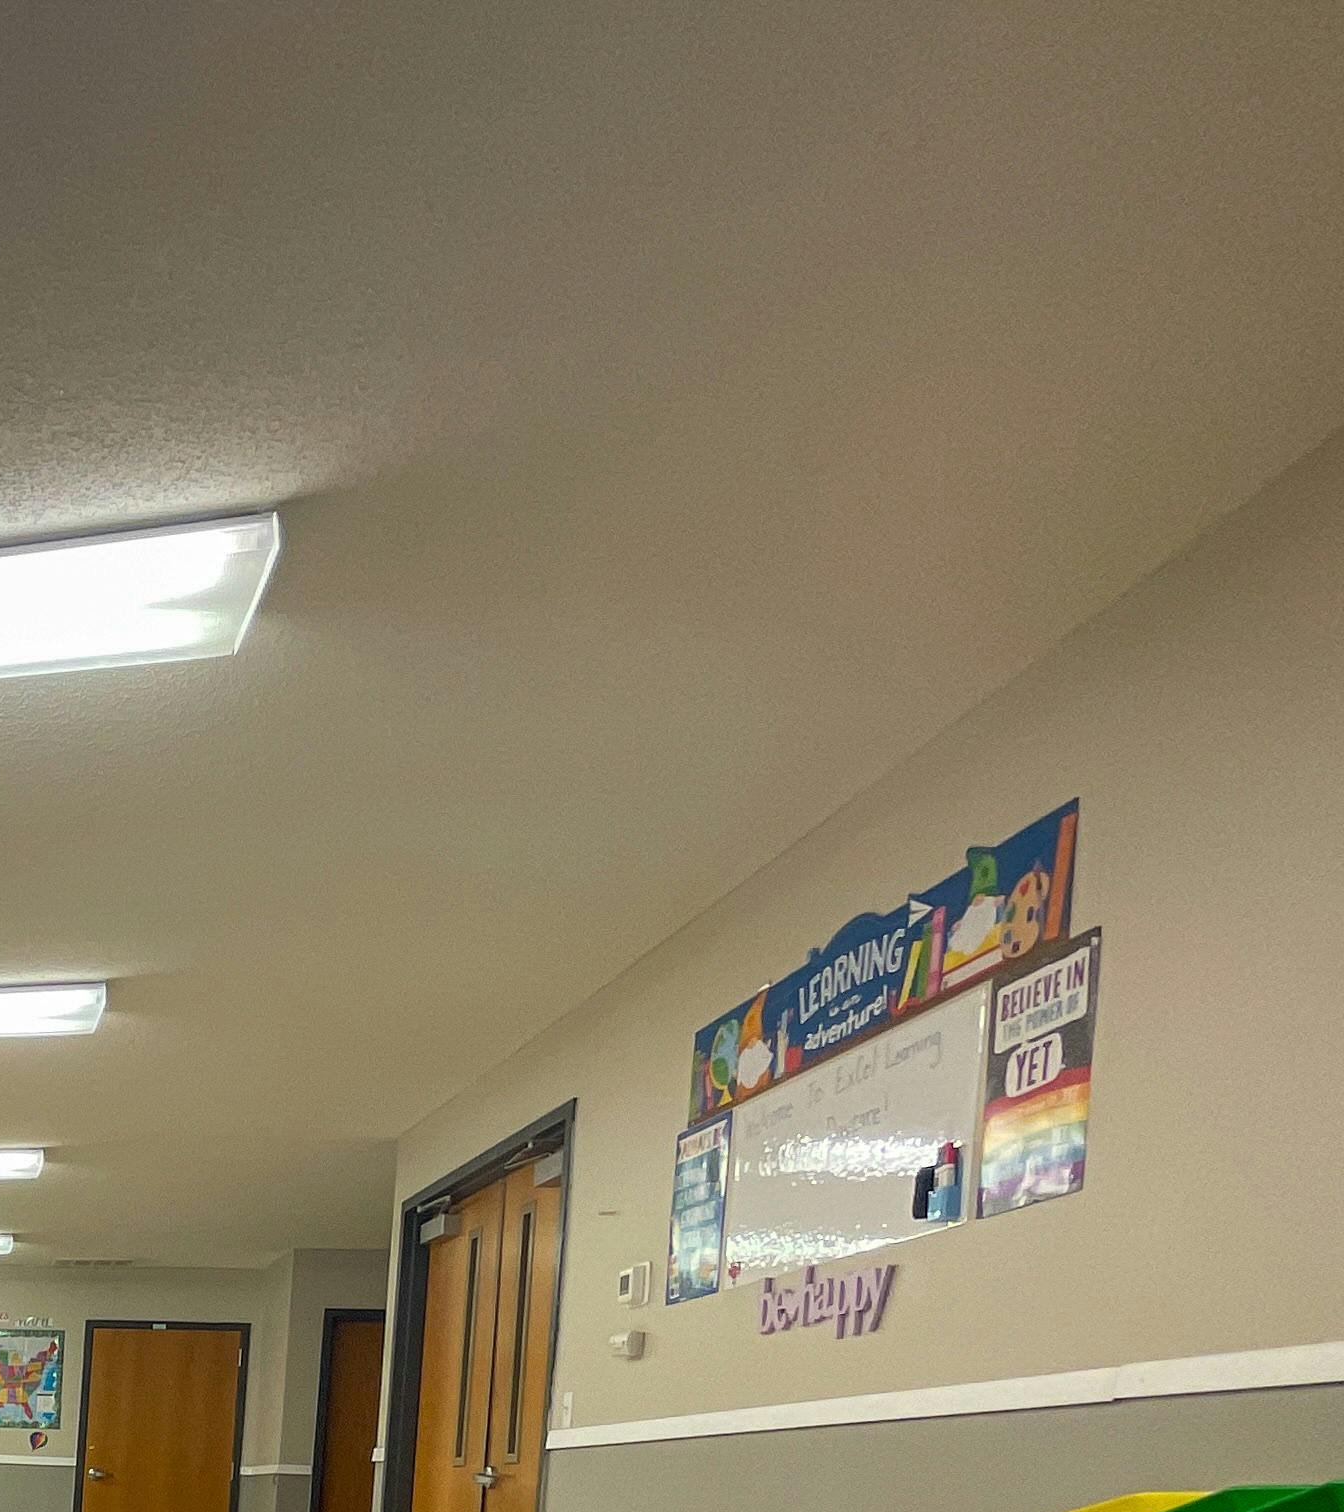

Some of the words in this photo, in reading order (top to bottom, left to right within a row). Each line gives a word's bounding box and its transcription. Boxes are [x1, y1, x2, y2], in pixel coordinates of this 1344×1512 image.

[799, 928, 906, 1024] LEARNING
[1000, 969, 1063, 1022] BELIEVE
[1065, 956, 1086, 991] IN
[804, 984, 888, 1051] adventure!
[1016, 1040, 1054, 1091] YET
[760, 1277, 800, 1335] be
[802, 1265, 899, 1340] happy
